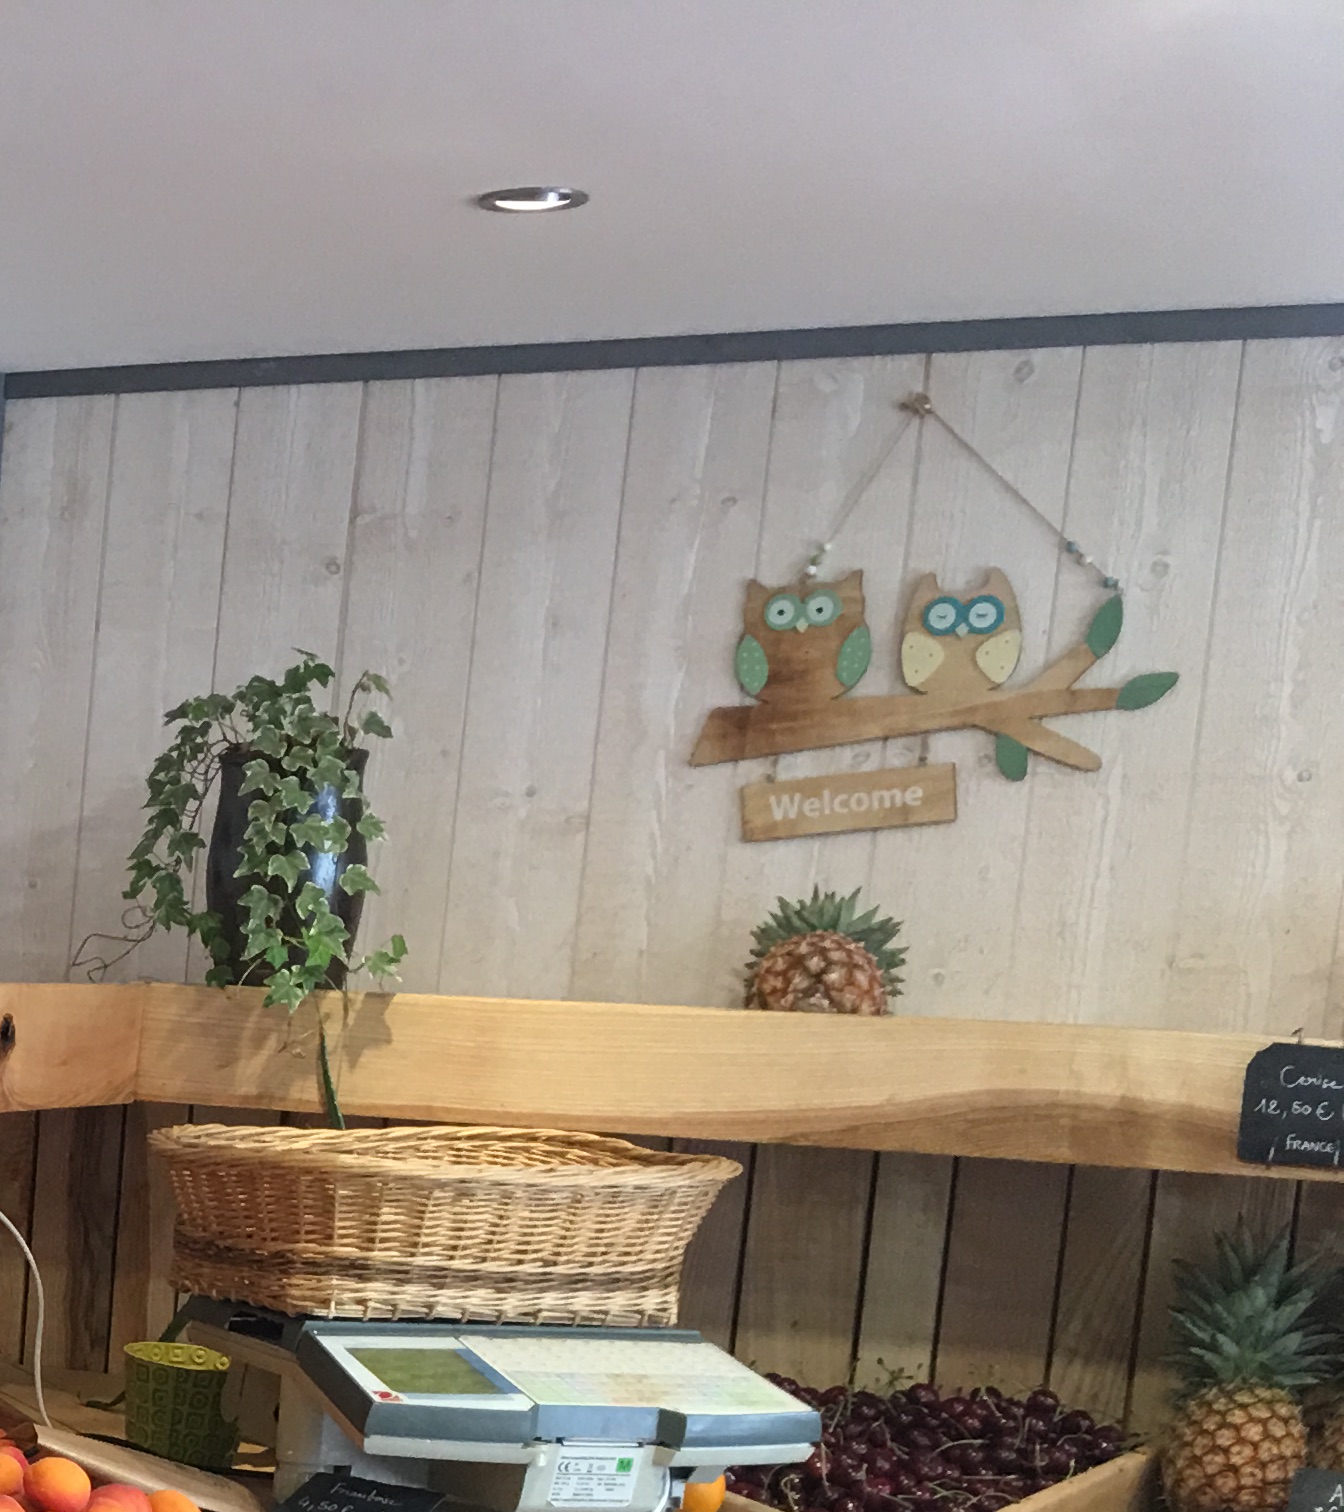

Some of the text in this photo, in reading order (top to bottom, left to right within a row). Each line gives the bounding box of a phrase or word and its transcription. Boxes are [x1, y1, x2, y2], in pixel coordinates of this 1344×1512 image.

[769, 784, 923, 820] Welcome
[1254, 1098, 1311, 1120] 12,50
[1316, 1101, 1335, 1120] €
[1285, 1133, 1334, 1153] FRANCE
